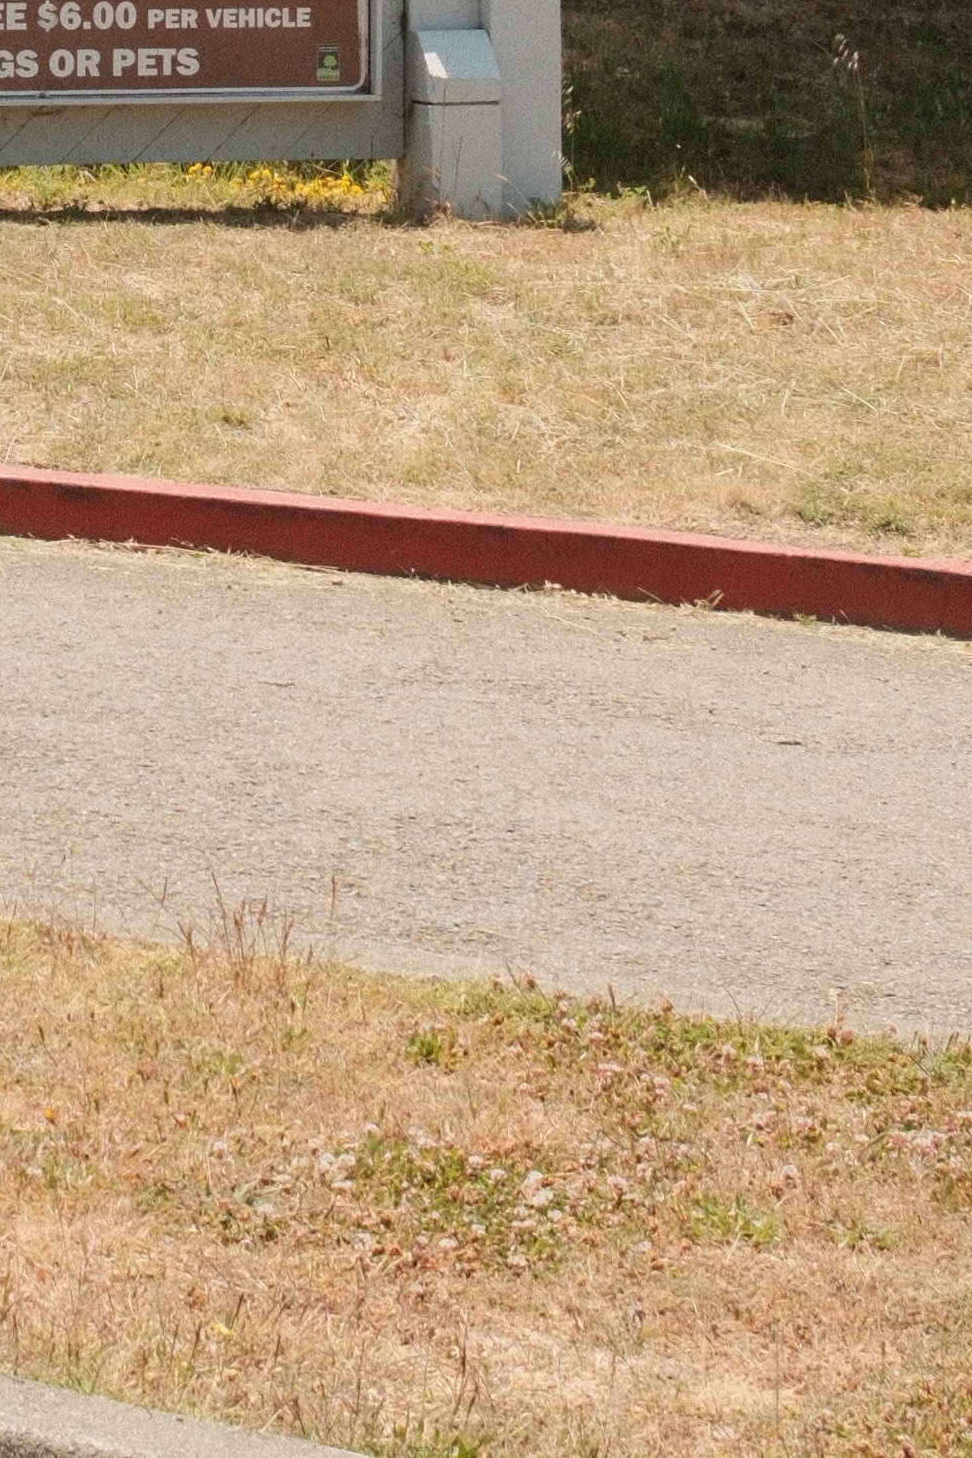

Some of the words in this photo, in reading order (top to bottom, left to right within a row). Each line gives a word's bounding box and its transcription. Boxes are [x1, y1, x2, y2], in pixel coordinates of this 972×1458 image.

[38, 0, 137, 32] $6.00
[148, 8, 198, 29] PER
[205, 7, 311, 28] VEHICLE
[49, 49, 101, 78] OR
[112, 47, 200, 77] PETS
